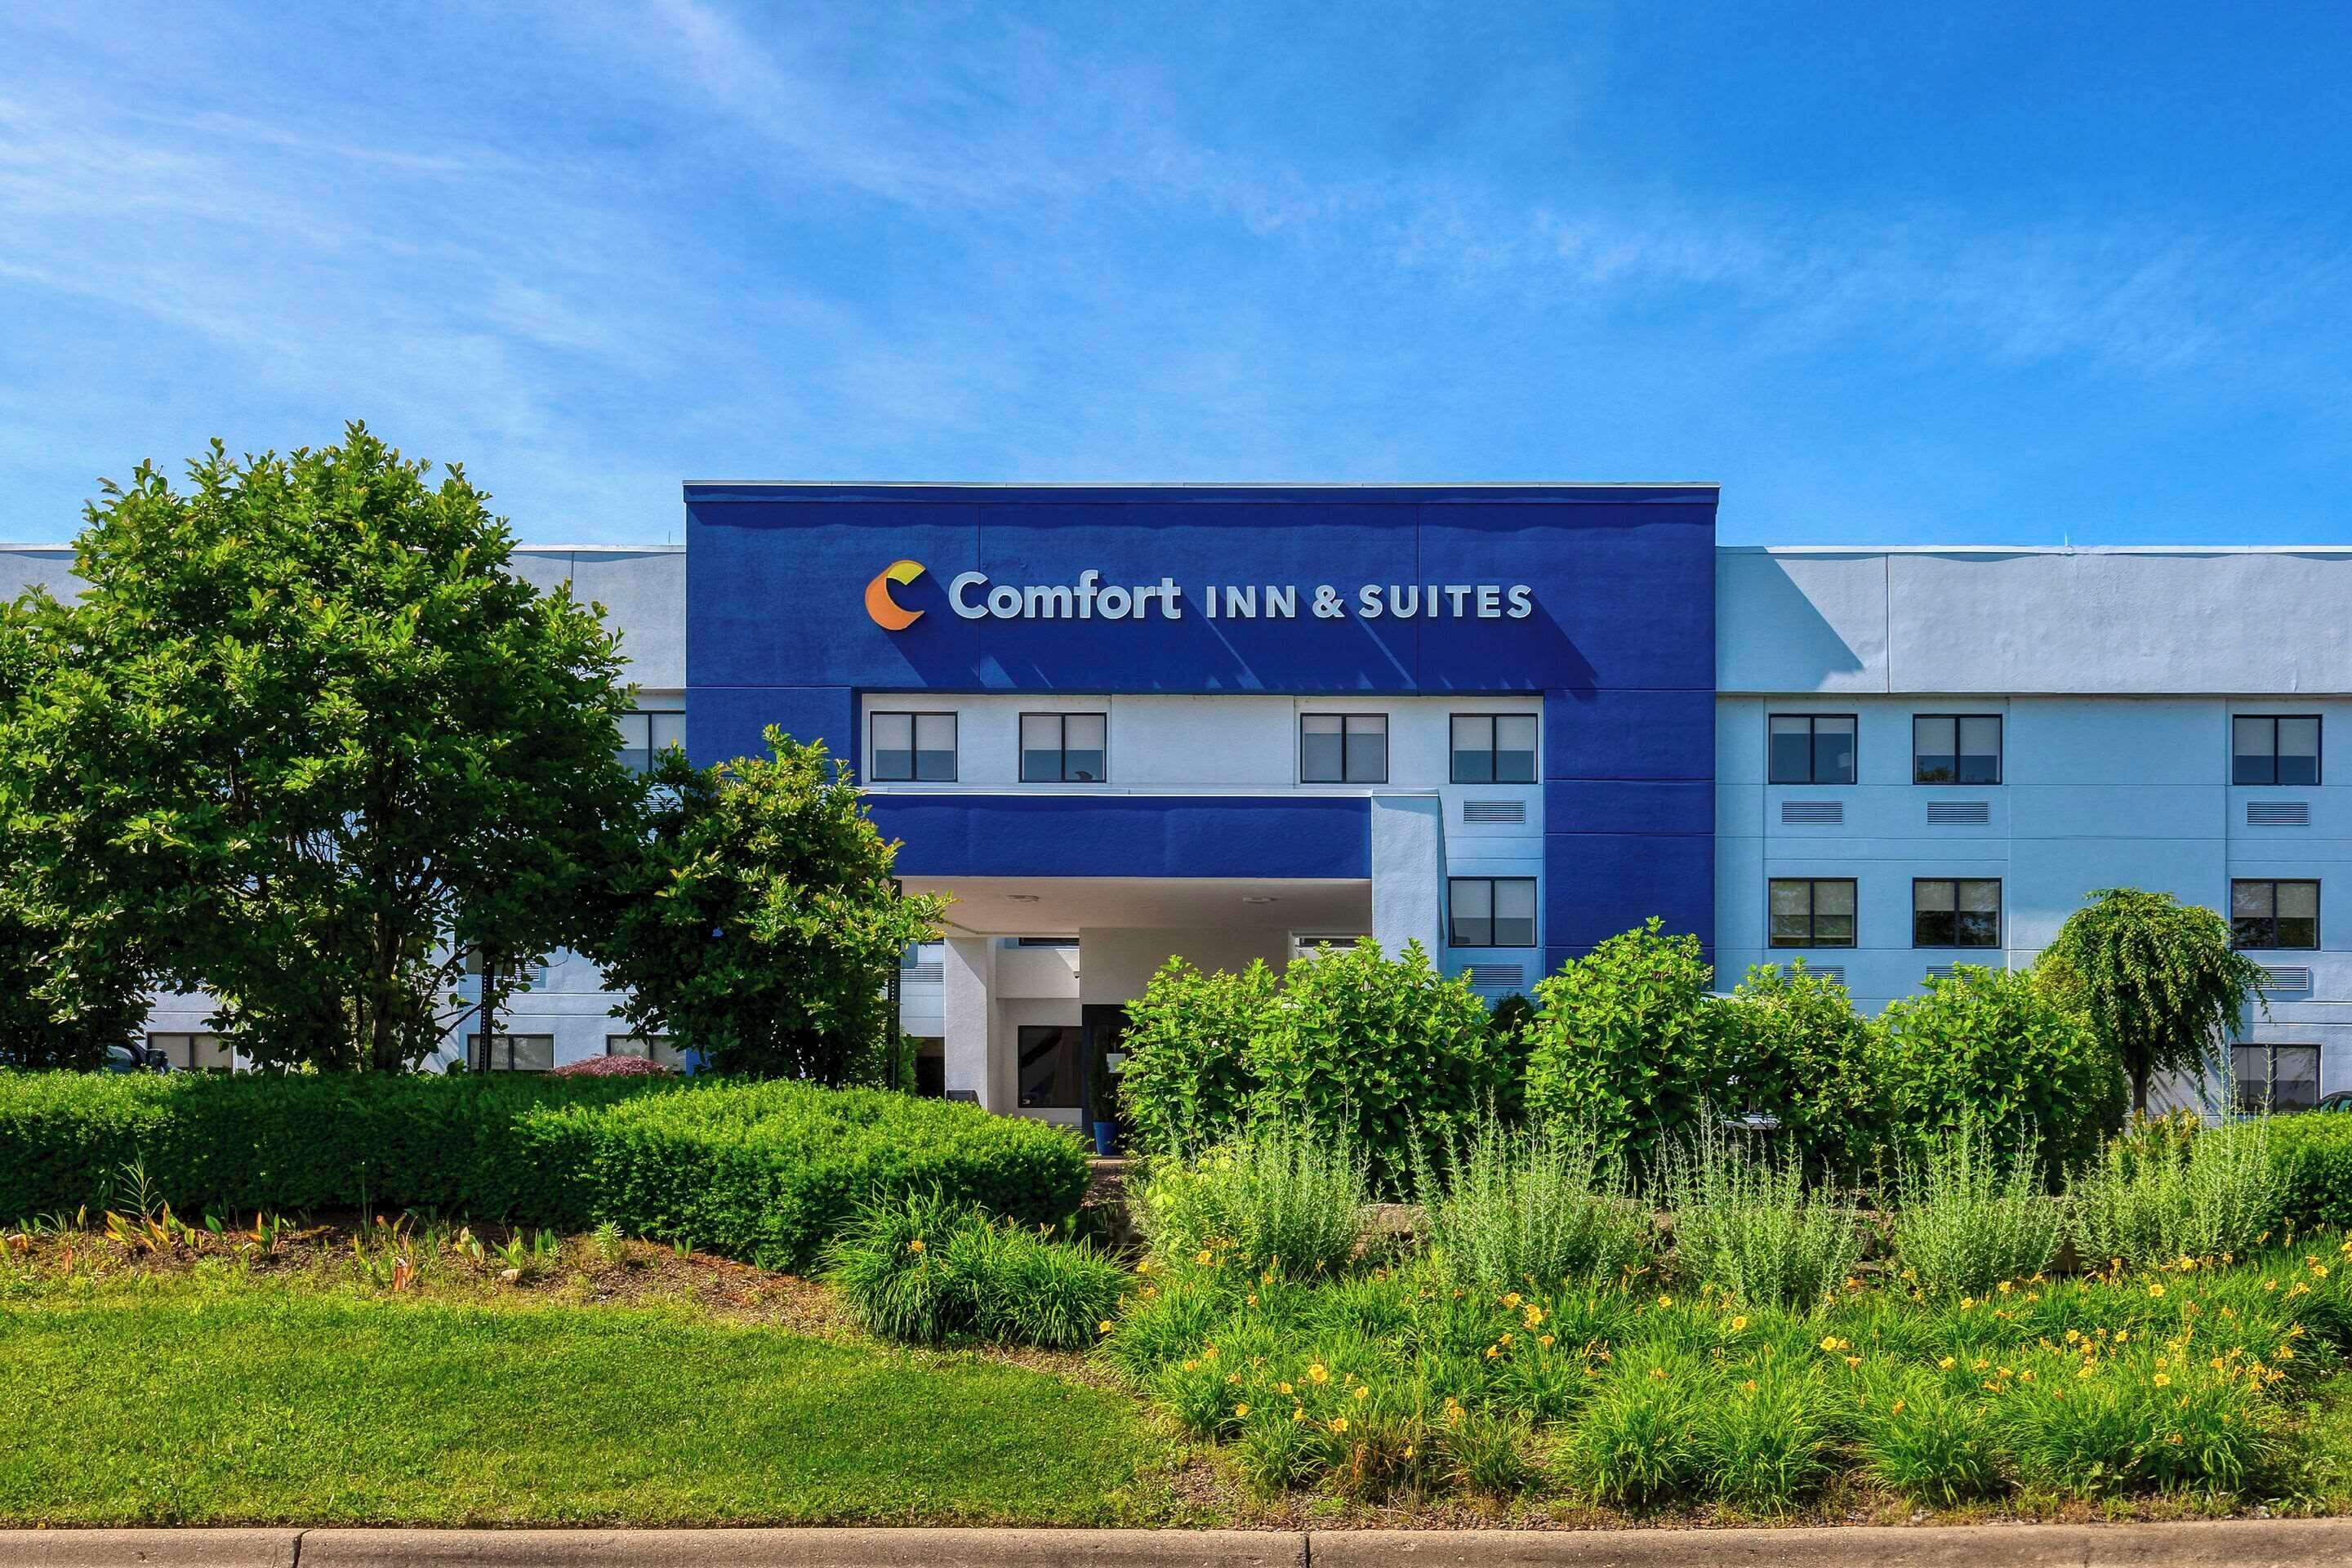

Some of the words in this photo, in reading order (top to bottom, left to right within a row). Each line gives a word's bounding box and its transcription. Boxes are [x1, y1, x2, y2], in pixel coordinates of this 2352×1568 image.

[948, 569, 1183, 620] Comfort
[1206, 585, 1296, 619] INN
[1312, 584, 1346, 619] &
[1358, 584, 1533, 619] SUITES
